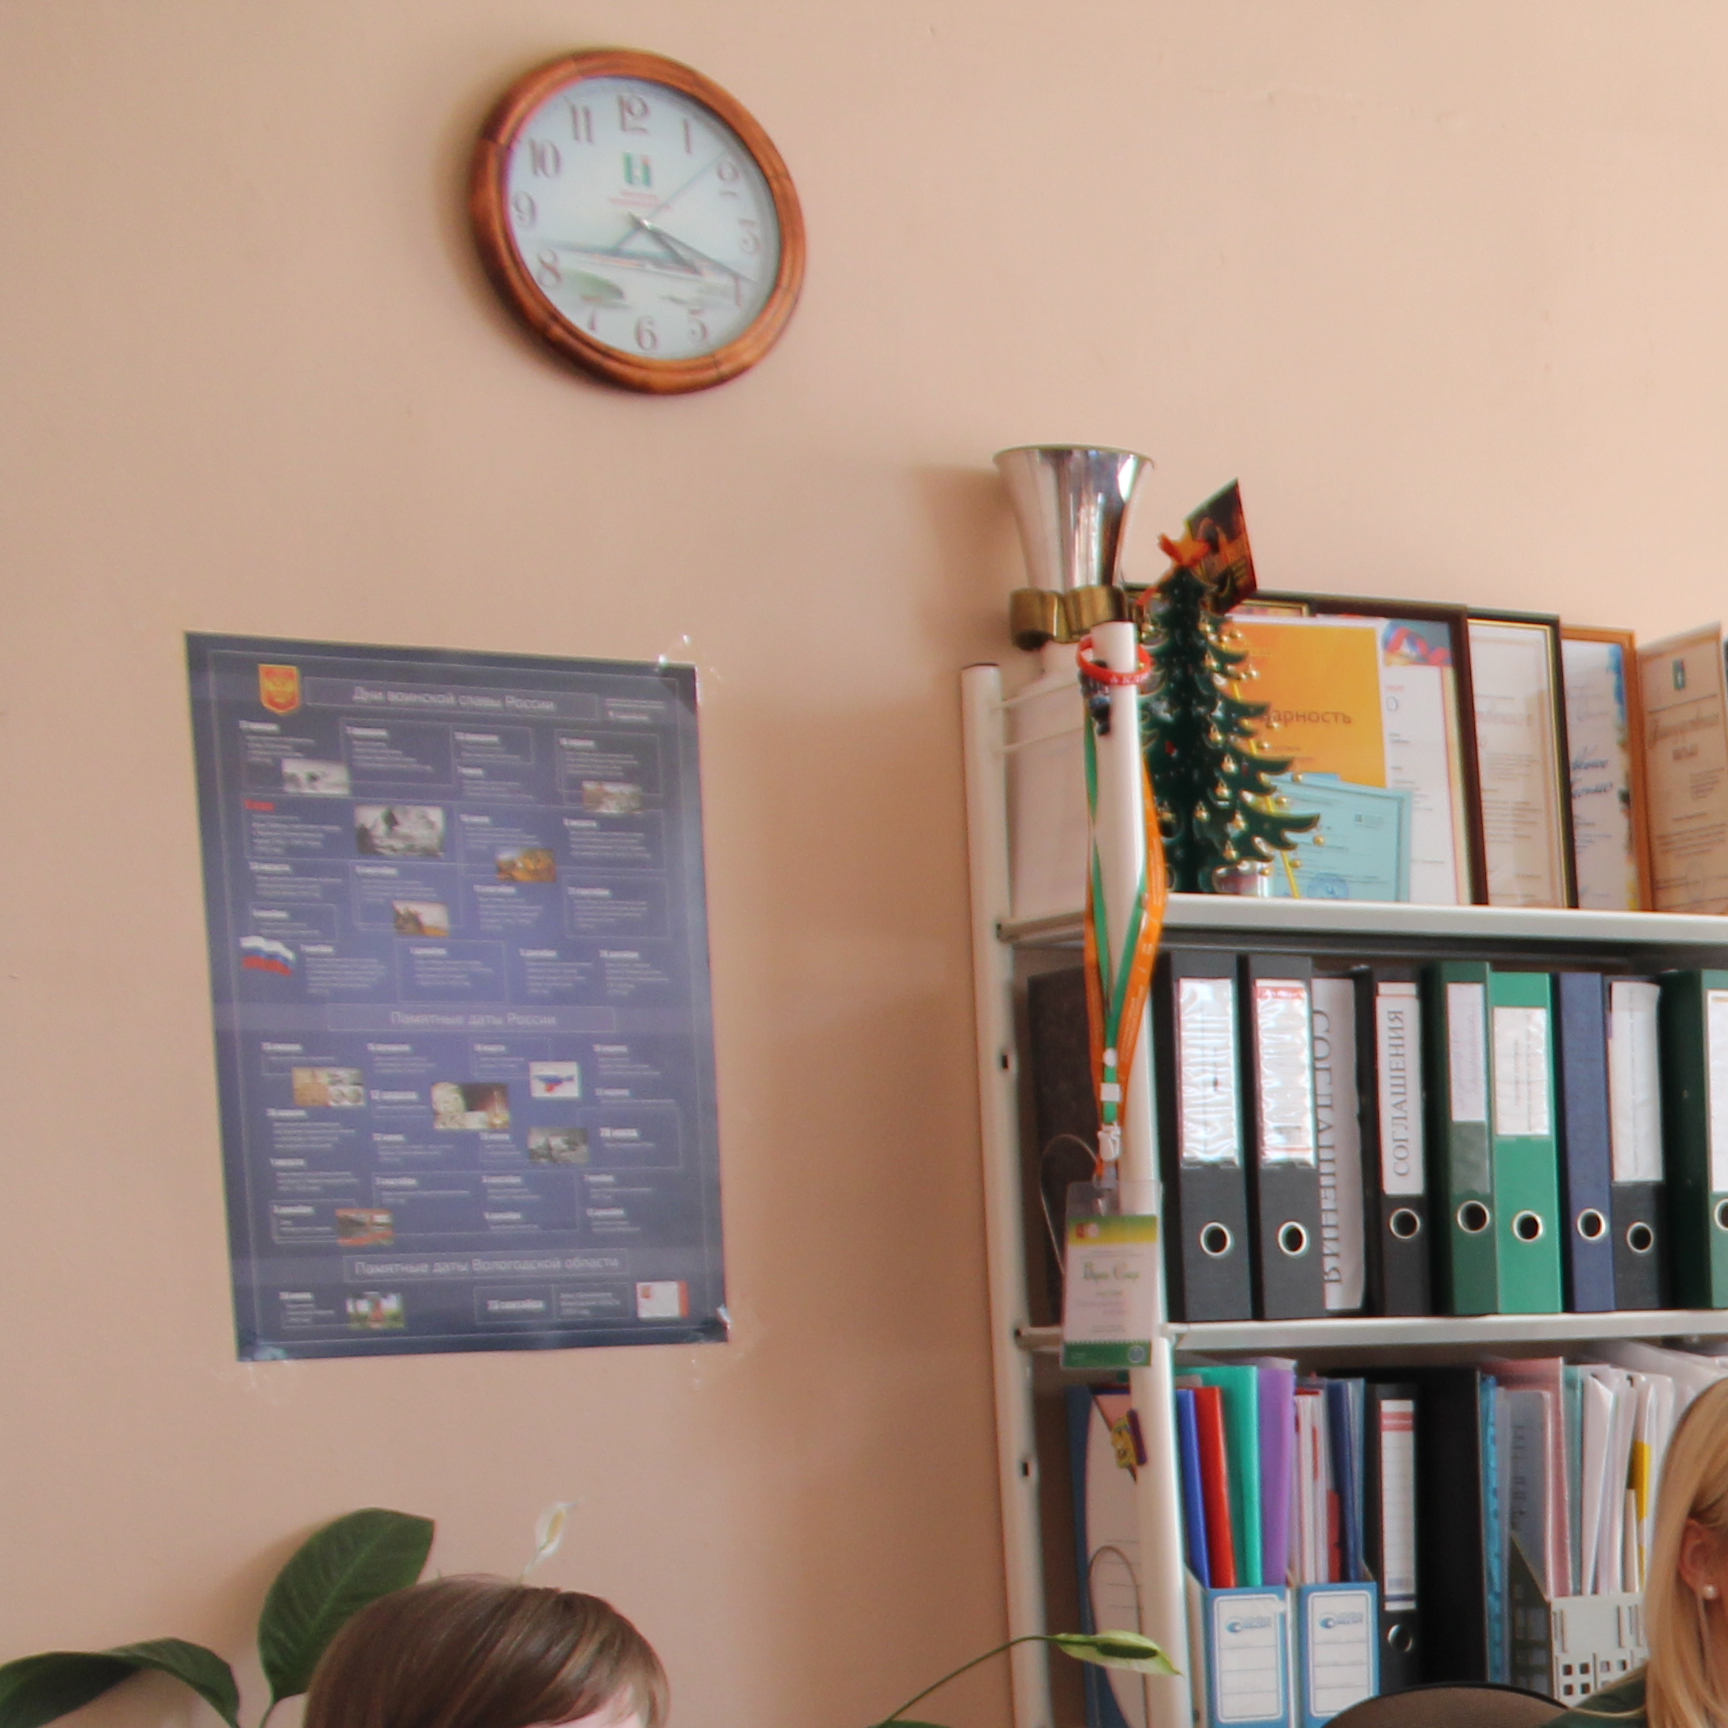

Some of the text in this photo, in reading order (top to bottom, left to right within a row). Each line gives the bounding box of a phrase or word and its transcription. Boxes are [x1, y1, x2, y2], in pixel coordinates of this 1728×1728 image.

[617, 94, 649, 134] 12
[529, 139, 561, 179] 10
[717, 160, 740, 200] 2
[511, 191, 536, 227] 9
[737, 218, 762, 255] 3
[537, 250, 562, 289] 8
[634, 315, 657, 352] 6
[504, 695, 556, 712] России
[1262, 708, 1352, 727] дарность
[391, 1011, 557, 1027] Памятные даты России
[1386, 1009, 1411, 1178] СОГЛАШЕНИЯ
[1312, 1009, 1343, 1285] СОГЛАШЕНИЯ
[355, 1256, 619, 1275] Памятные даты Вологодской области
